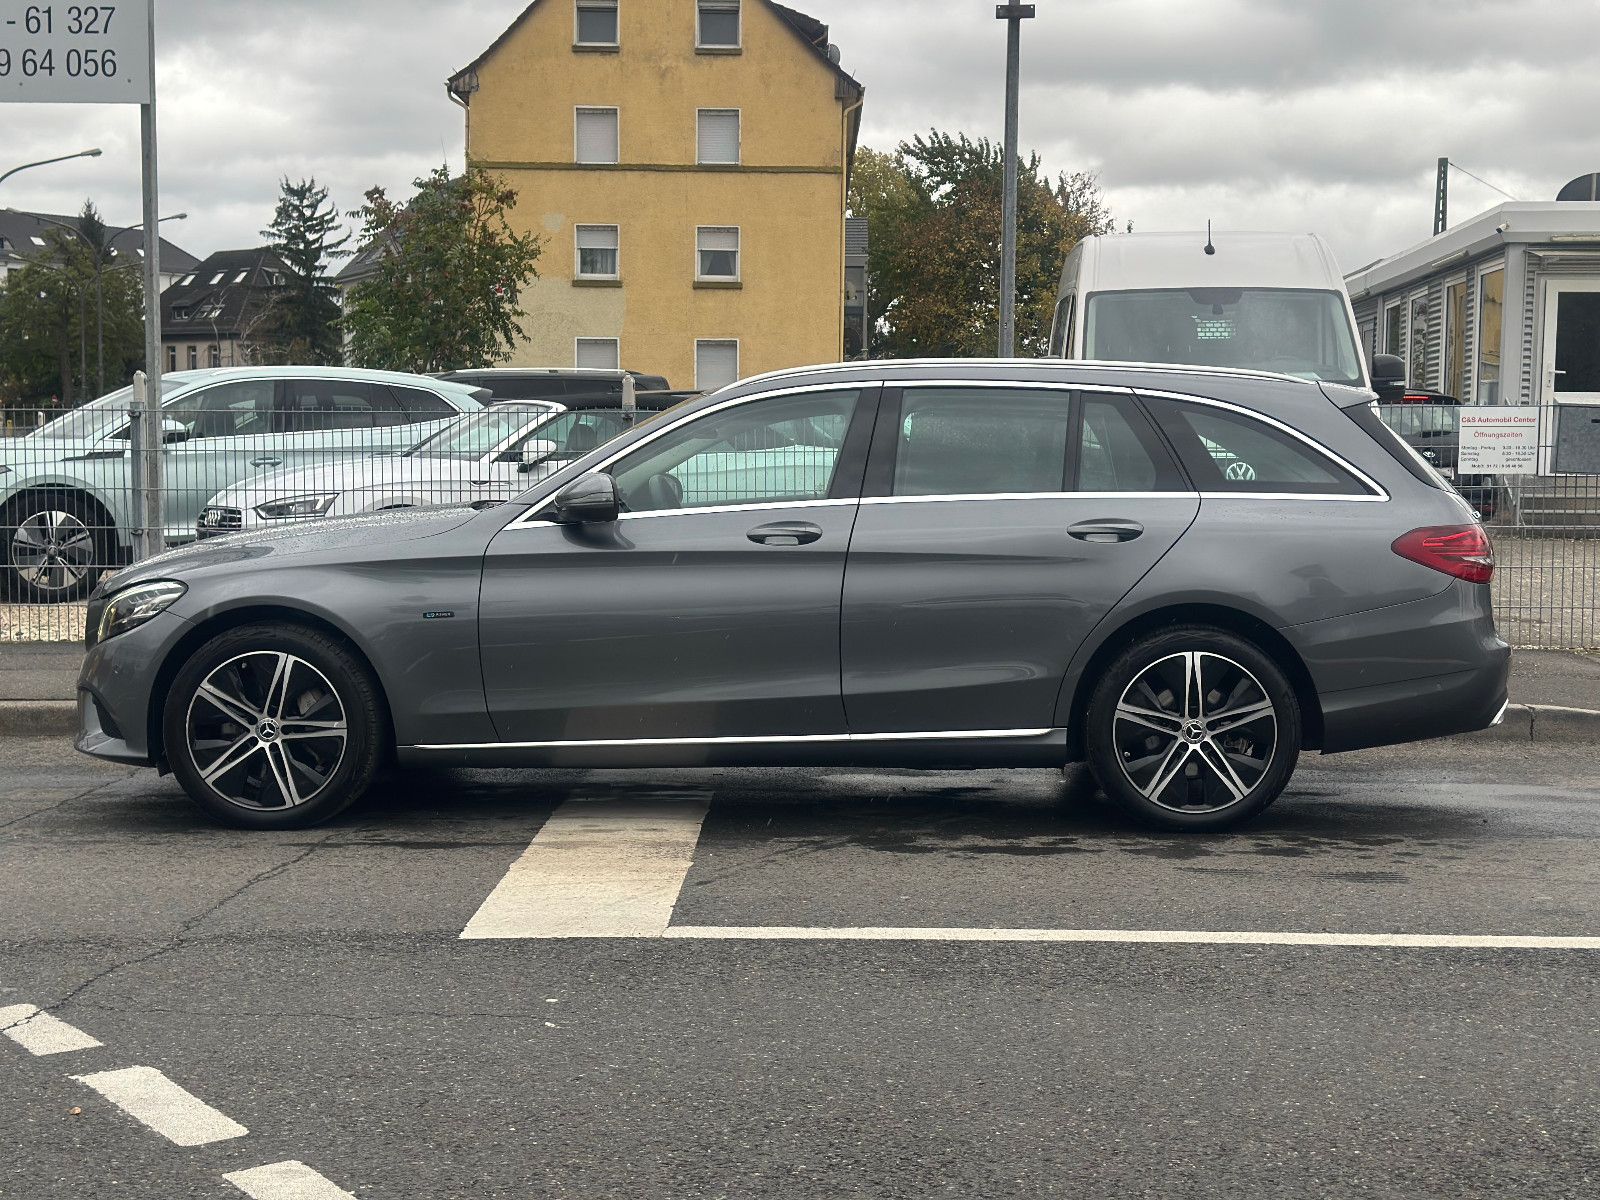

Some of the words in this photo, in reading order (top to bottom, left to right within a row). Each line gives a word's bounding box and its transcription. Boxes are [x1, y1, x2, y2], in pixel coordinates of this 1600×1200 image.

[25, 6, 52, 34] 61
[67, 6, 116, 34] 327
[22, 48, 55, 76] 64
[66, 49, 117, 77] 056
[1473, 430, 1523, 439] Öffnungszeiten
